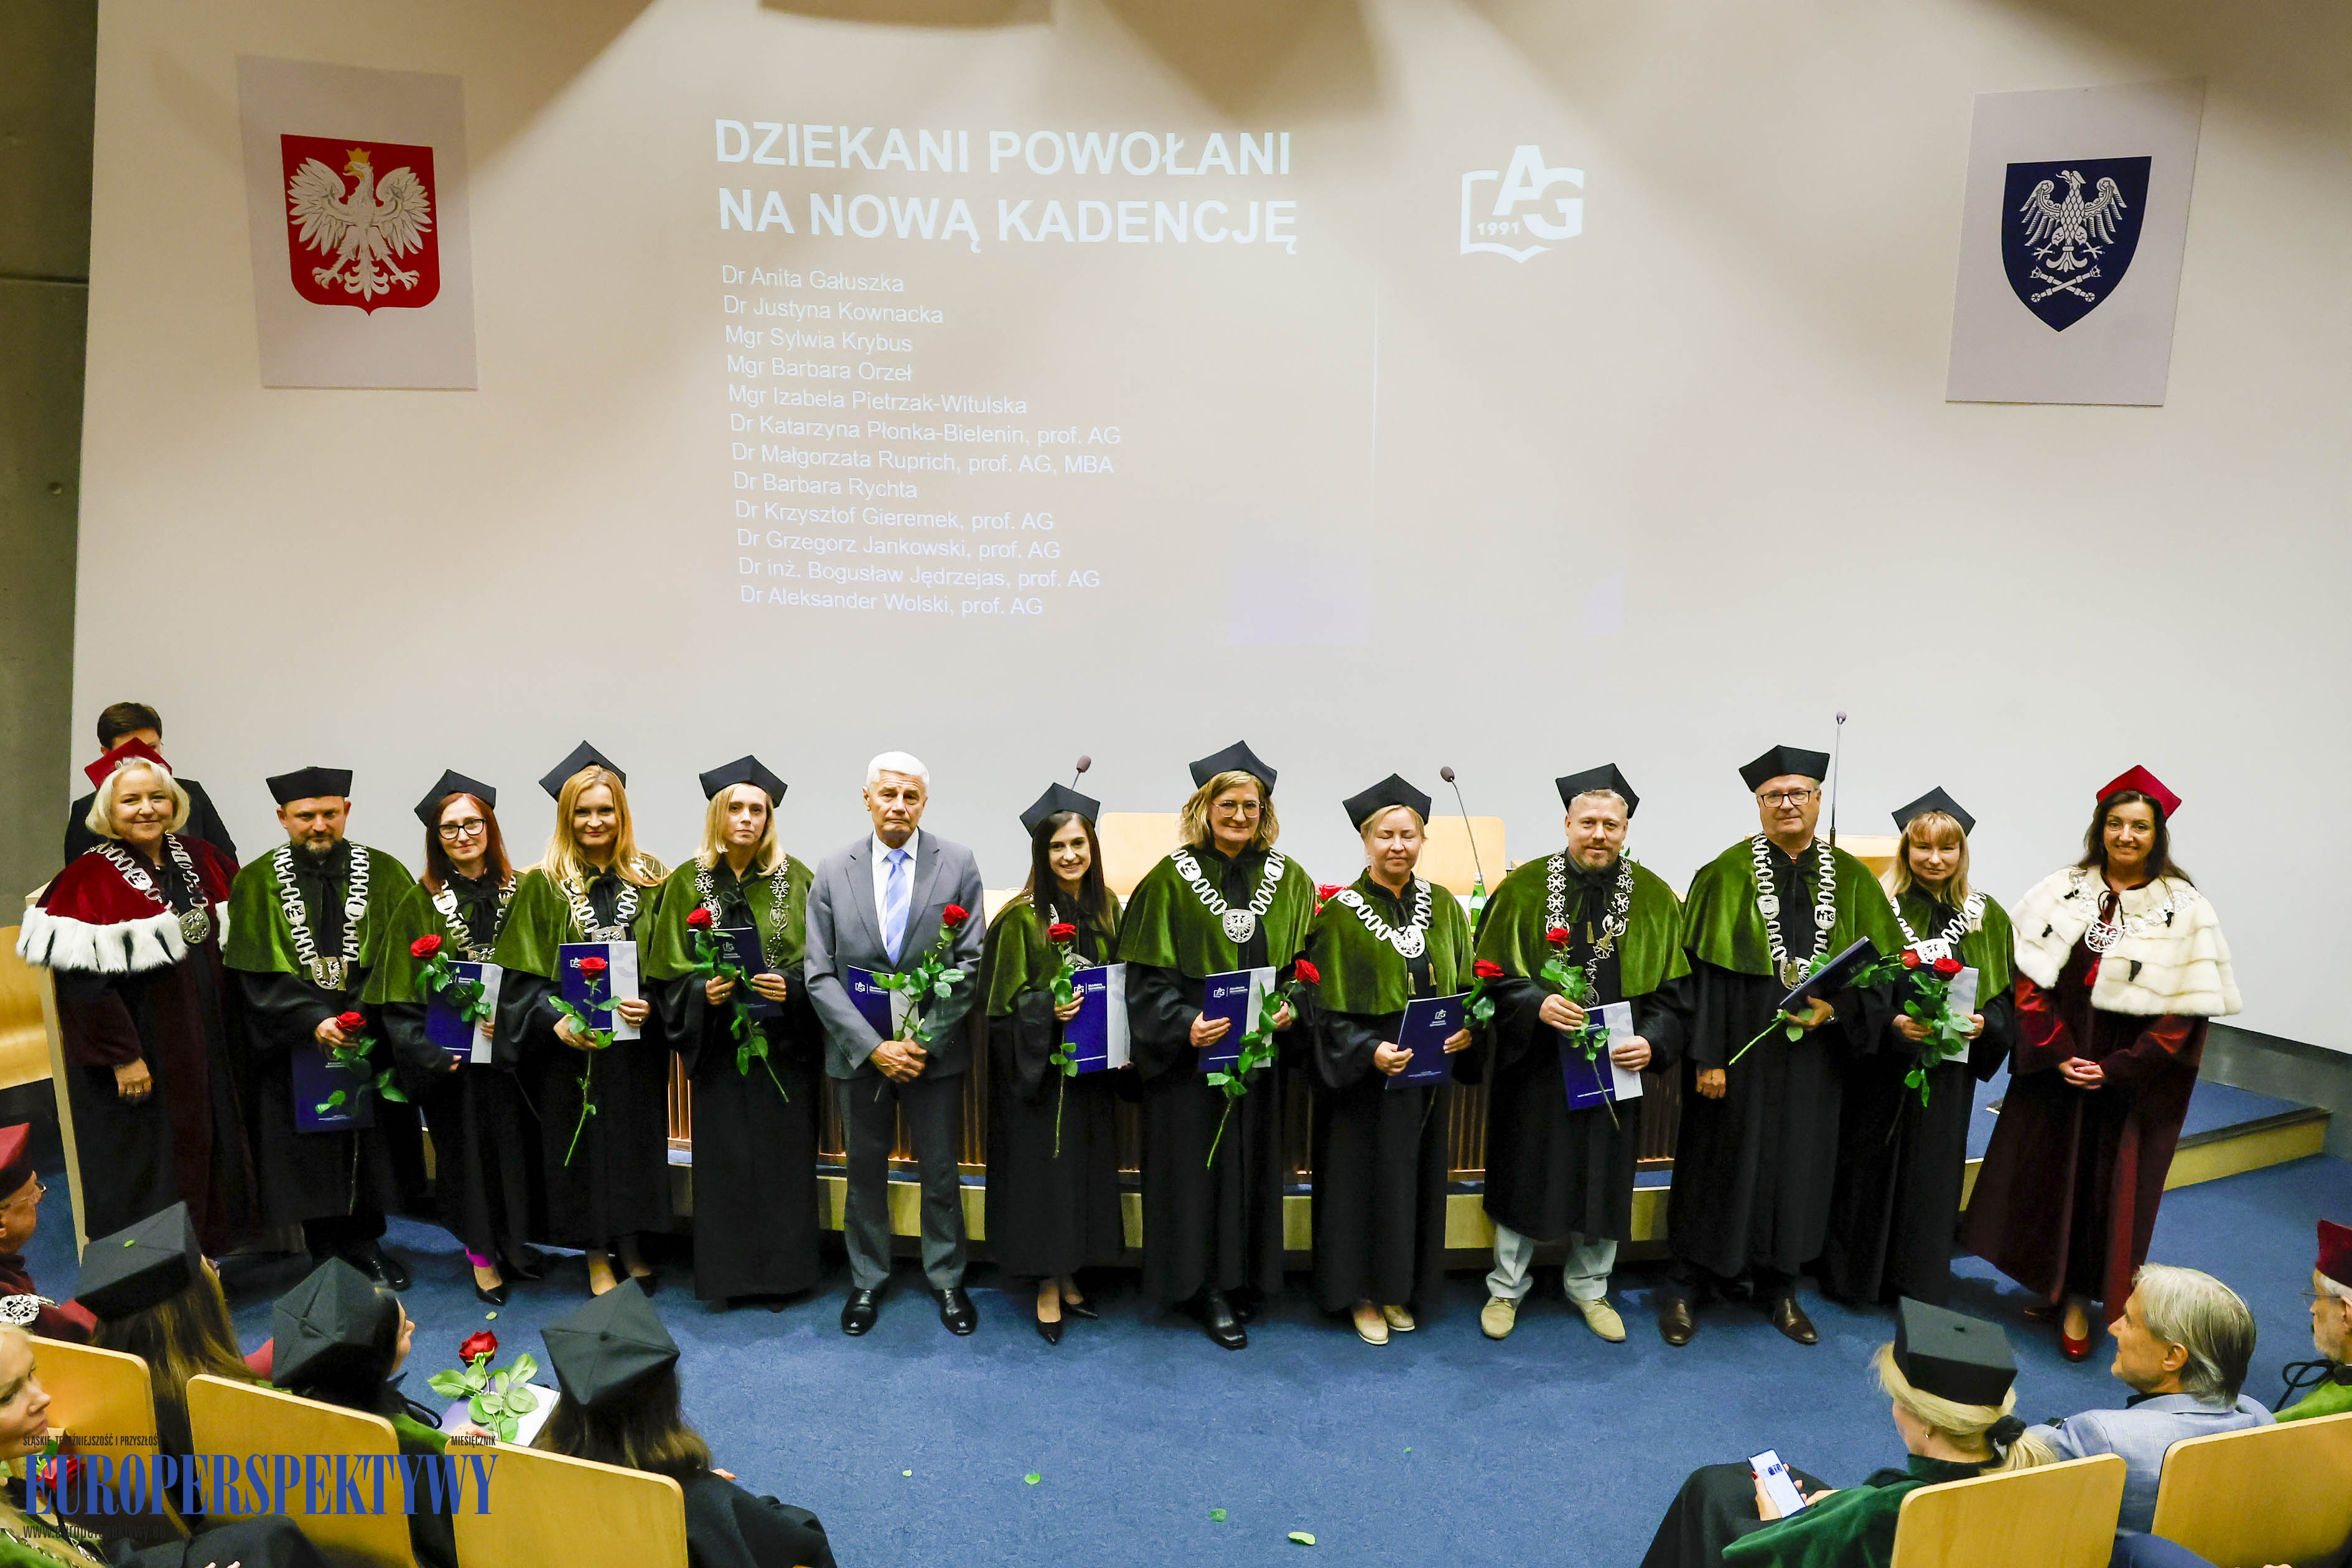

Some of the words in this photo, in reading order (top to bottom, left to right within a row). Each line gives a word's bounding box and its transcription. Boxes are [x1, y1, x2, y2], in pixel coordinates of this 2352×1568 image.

[717, 120, 968, 171] DZIEKANI
[991, 132, 1290, 174] POWOŁANI
[1492, 145, 1584, 240] AG
[720, 189, 795, 233] NA
[811, 194, 980, 252] NOWĄ
[999, 200, 1296, 254] KADENCJĘ
[1477, 222, 1519, 236] 1991
[722, 264, 745, 284] Dr
[750, 267, 802, 287] Anita
[810, 270, 904, 292] Gałuszka
[724, 294, 747, 314] Dr
[754, 298, 831, 322] Justyna
[839, 302, 944, 323] Kownacka
[726, 325, 764, 348] Mgr
[770, 328, 836, 351] Sylwia
[842, 332, 913, 355] Krybus
[727, 355, 765, 378] Mgr
[772, 357, 851, 379] Barbara
[859, 362, 913, 381] Orzeł
[729, 383, 767, 408] Mgr
[773, 387, 845, 408] Izabela
[852, 391, 1027, 414] Pietrzak-Witulska
[730, 413, 754, 432] Dr
[760, 416, 860, 441] Katarzyna
[867, 421, 1030, 446] Płonka-Bielenin,
[1038, 426, 1081, 448] prof.
[1088, 426, 1121, 444] AG
[732, 442, 755, 460] Dr
[762, 444, 871, 469] Małgorzata
[879, 450, 961, 474] Ruprich,
[969, 454, 1012, 475] prof.
[1019, 455, 1057, 475] AG,
[1065, 455, 1114, 474] MBA
[734, 471, 758, 490] Dr
[763, 473, 842, 494] Barbara
[849, 478, 918, 500] Rychta
[735, 500, 758, 518] Dr
[765, 502, 856, 526] Krzysztof
[862, 507, 964, 530] Gieremek,
[972, 512, 1015, 533] prof.
[1021, 512, 1054, 530] AG
[737, 528, 760, 546] Dr
[767, 530, 857, 555] Grzegorz
[863, 536, 971, 559] Jankowski,
[979, 541, 1022, 561] prof.
[1028, 541, 1061, 559] AG
[739, 557, 761, 574] Dr
[768, 559, 801, 577] inż.
[808, 561, 903, 584] Bogusław
[910, 566, 1010, 590] Jędrzejas,
[1019, 569, 1062, 591] prof.
[1067, 569, 1101, 587] AG
[741, 585, 763, 603] Dr
[768, 587, 878, 609] Aleksander
[884, 594, 954, 615] Wolski,
[961, 597, 1004, 617] prof.
[1010, 597, 1043, 615] AG
